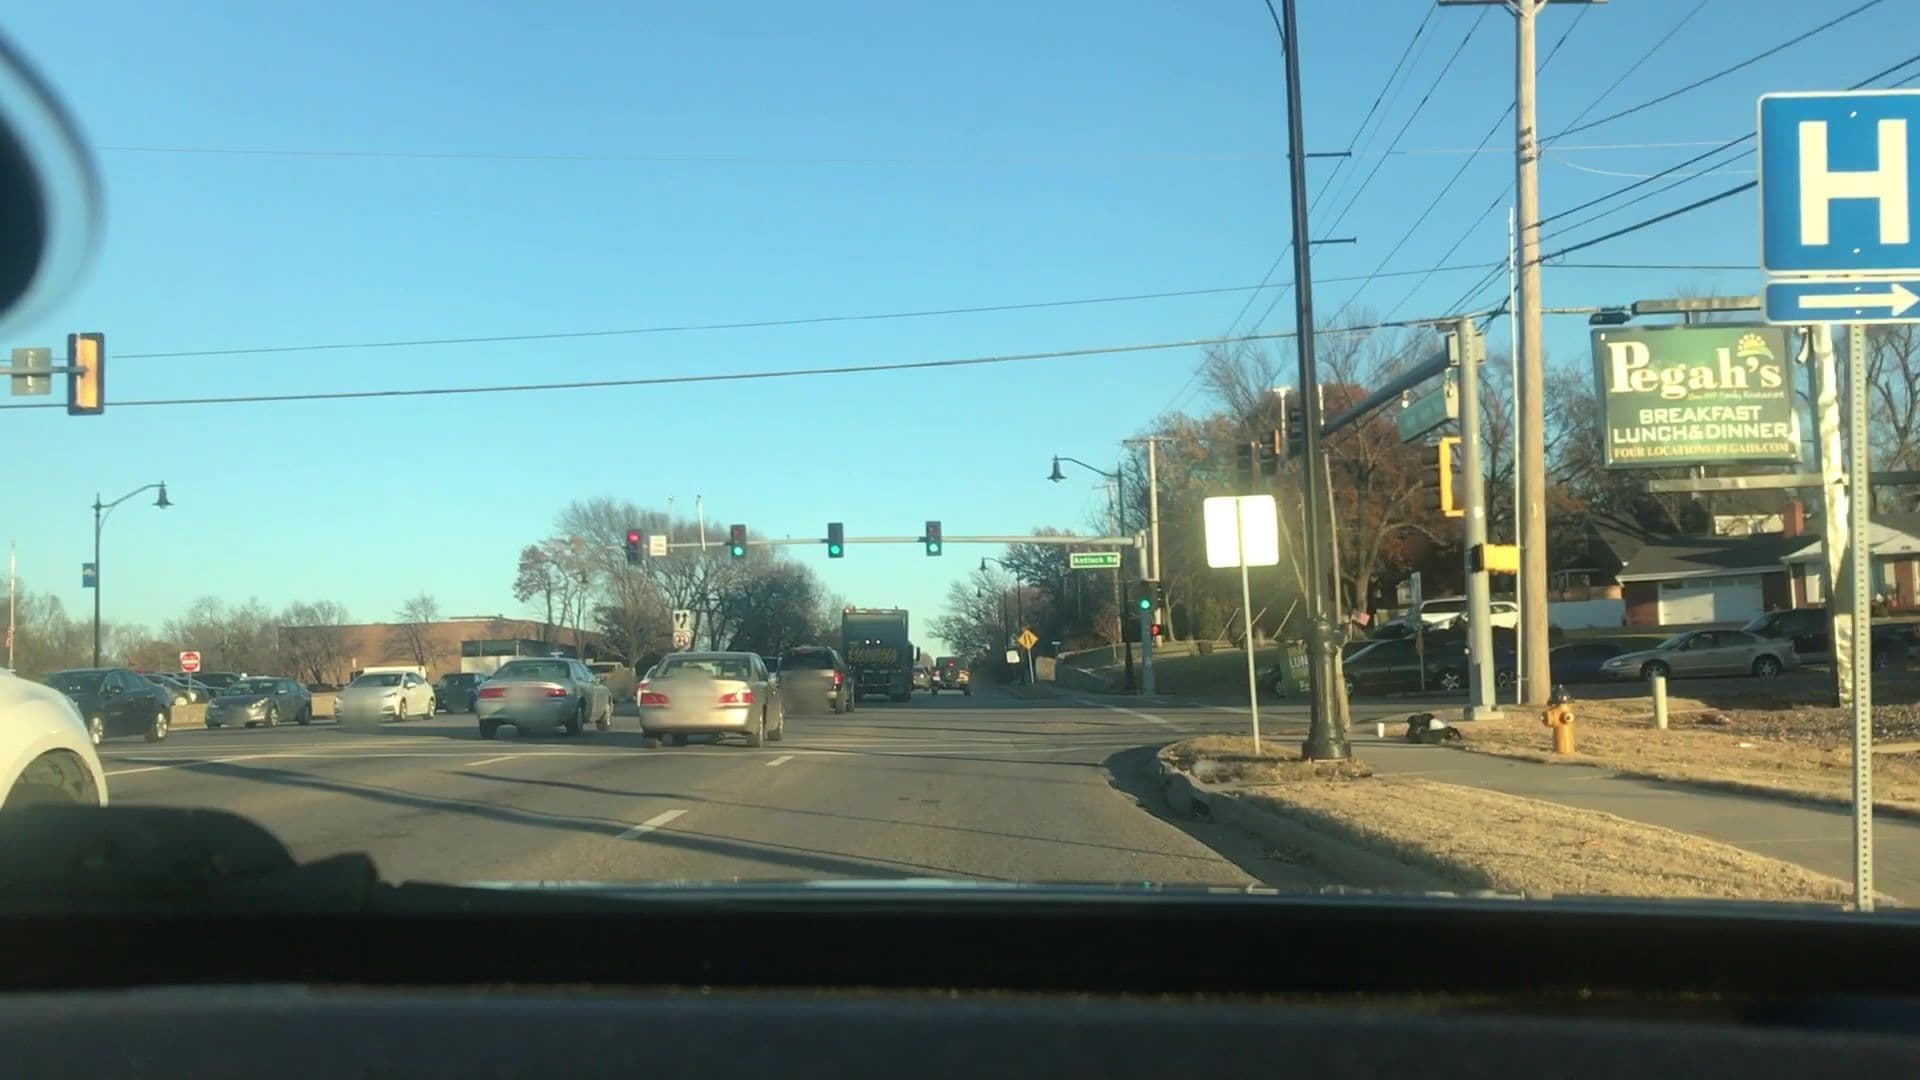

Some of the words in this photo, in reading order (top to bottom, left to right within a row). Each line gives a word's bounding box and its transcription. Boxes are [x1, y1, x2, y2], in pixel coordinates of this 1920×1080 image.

[1799, 119, 1909, 245] H
[1607, 340, 1783, 400] Pegah's
[1639, 405, 1762, 425] BREAKFAST
[1614, 444, 1644, 459] FOUR
[1288, 654, 1309, 668] LUN
